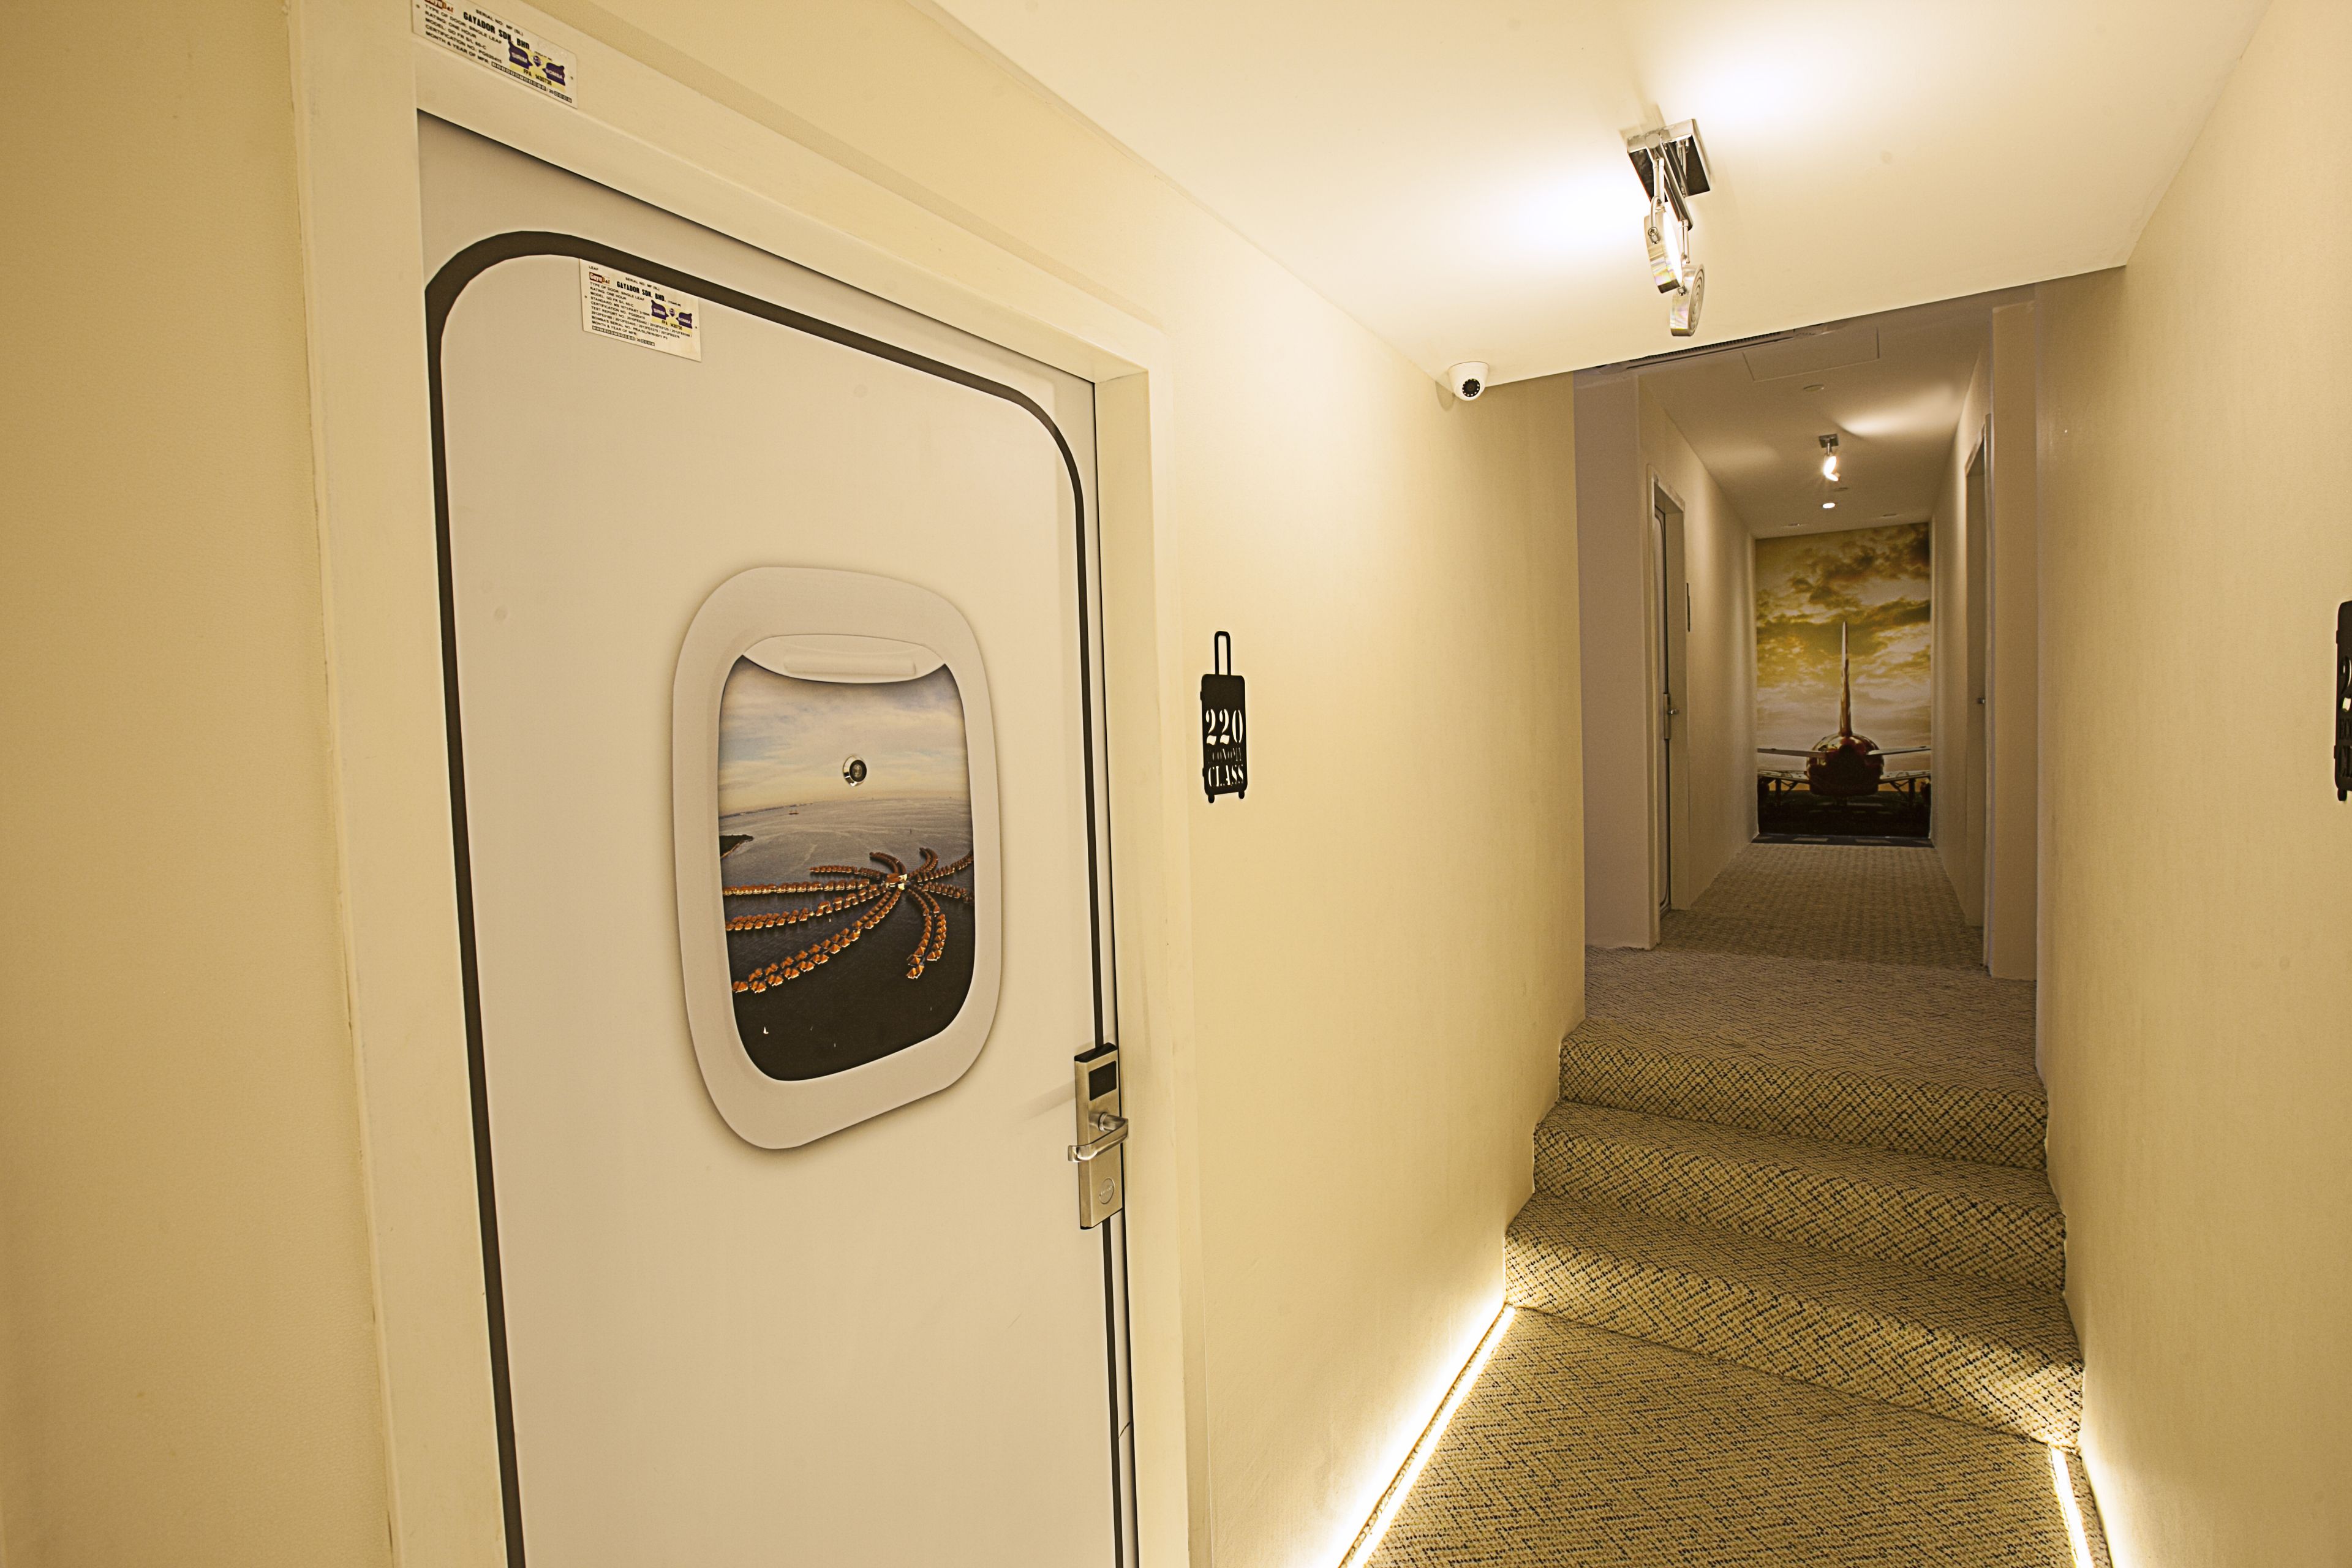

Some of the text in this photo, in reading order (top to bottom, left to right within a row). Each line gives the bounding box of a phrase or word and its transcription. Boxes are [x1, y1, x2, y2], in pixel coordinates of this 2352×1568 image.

[461, 28, 477, 39] HOUR
[463, 12, 495, 34] GAYADOR
[425, 24, 466, 46] CERTIFICATION
[426, 31, 445, 43] MONTH
[453, 43, 467, 53] YEAR
[617, 281, 639, 293] GAYADOR
[655, 293, 666, 302] BHD.
[1205, 708, 1243, 745] 220
[1207, 764, 1244, 788] CLASS
